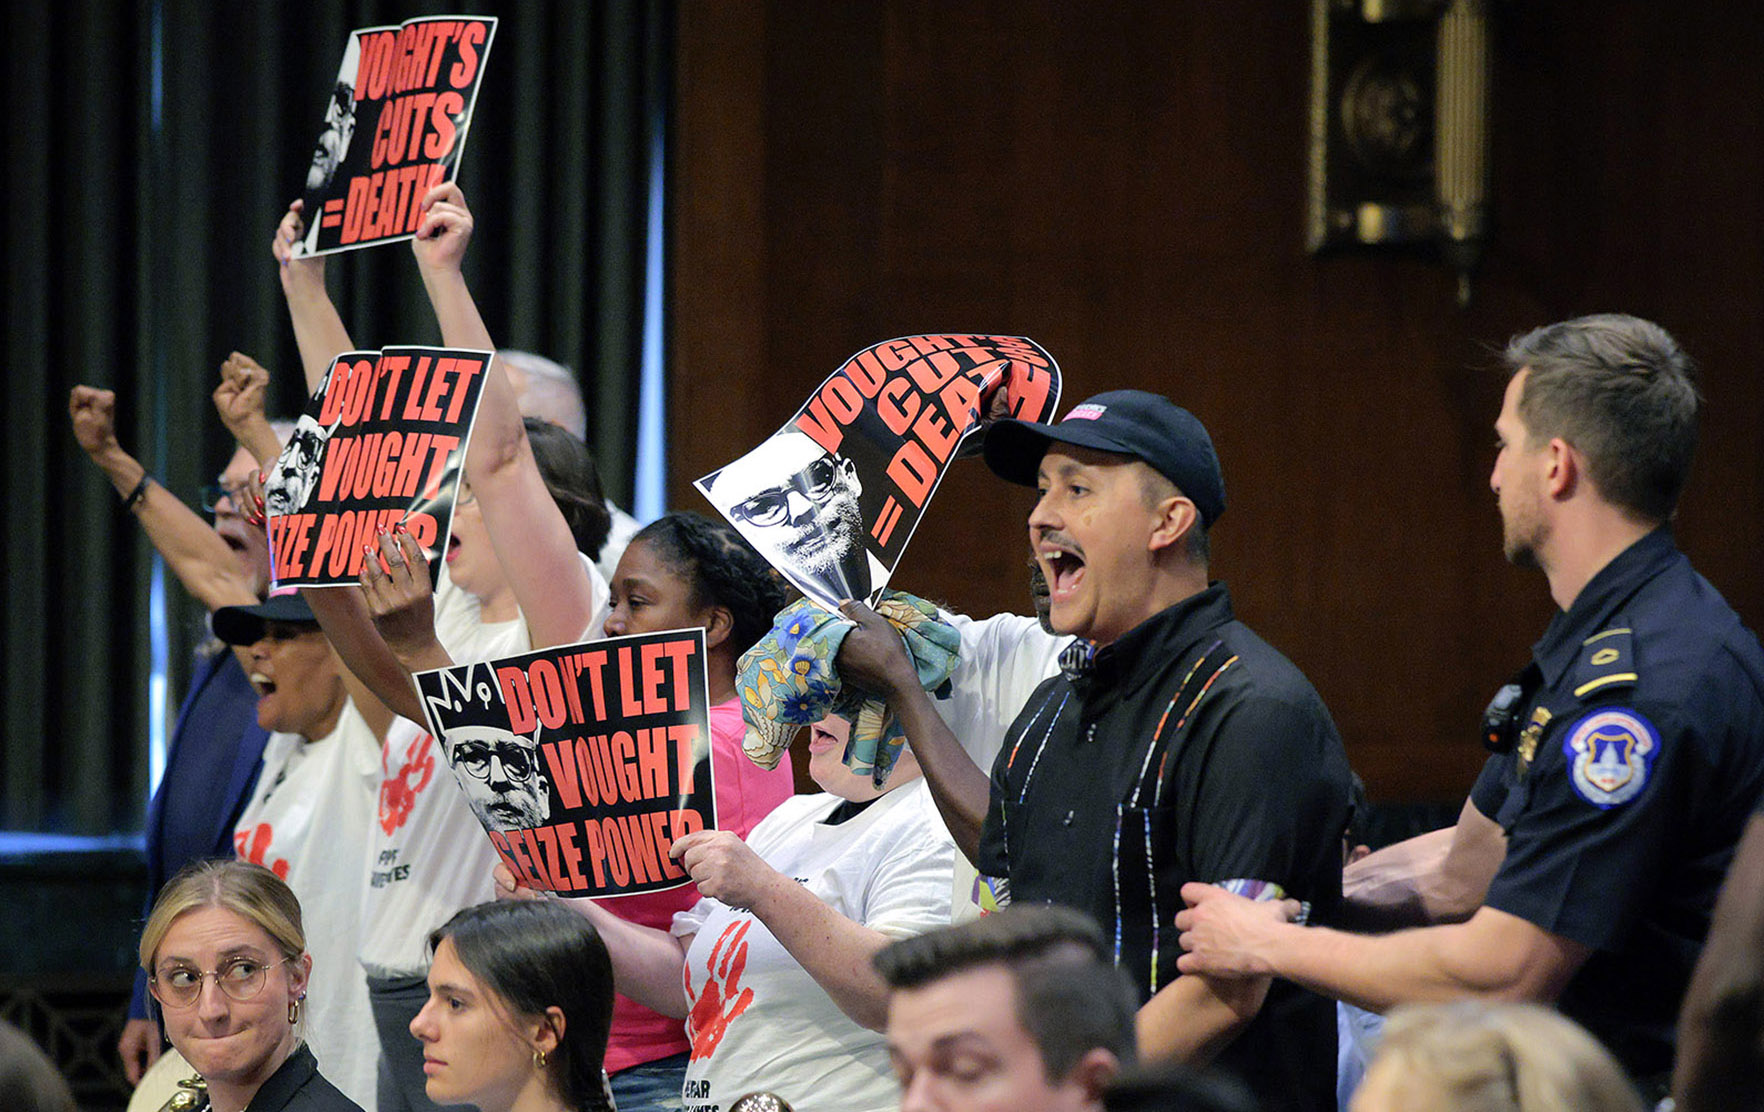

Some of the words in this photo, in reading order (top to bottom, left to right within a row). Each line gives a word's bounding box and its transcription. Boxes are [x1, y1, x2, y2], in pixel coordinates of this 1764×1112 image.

[371, 91, 464, 169] CUTS
[402, 356, 483, 424] LET
[795, 335, 1032, 455] VOUGHT'S
[877, 346, 1050, 436] CUTS
[317, 431, 460, 502] VOUGHT
[269, 513, 317, 580] EIZE
[496, 649, 608, 735] DON'T
[618, 639, 696, 718] LET
[541, 724, 700, 809] VOUGHT
